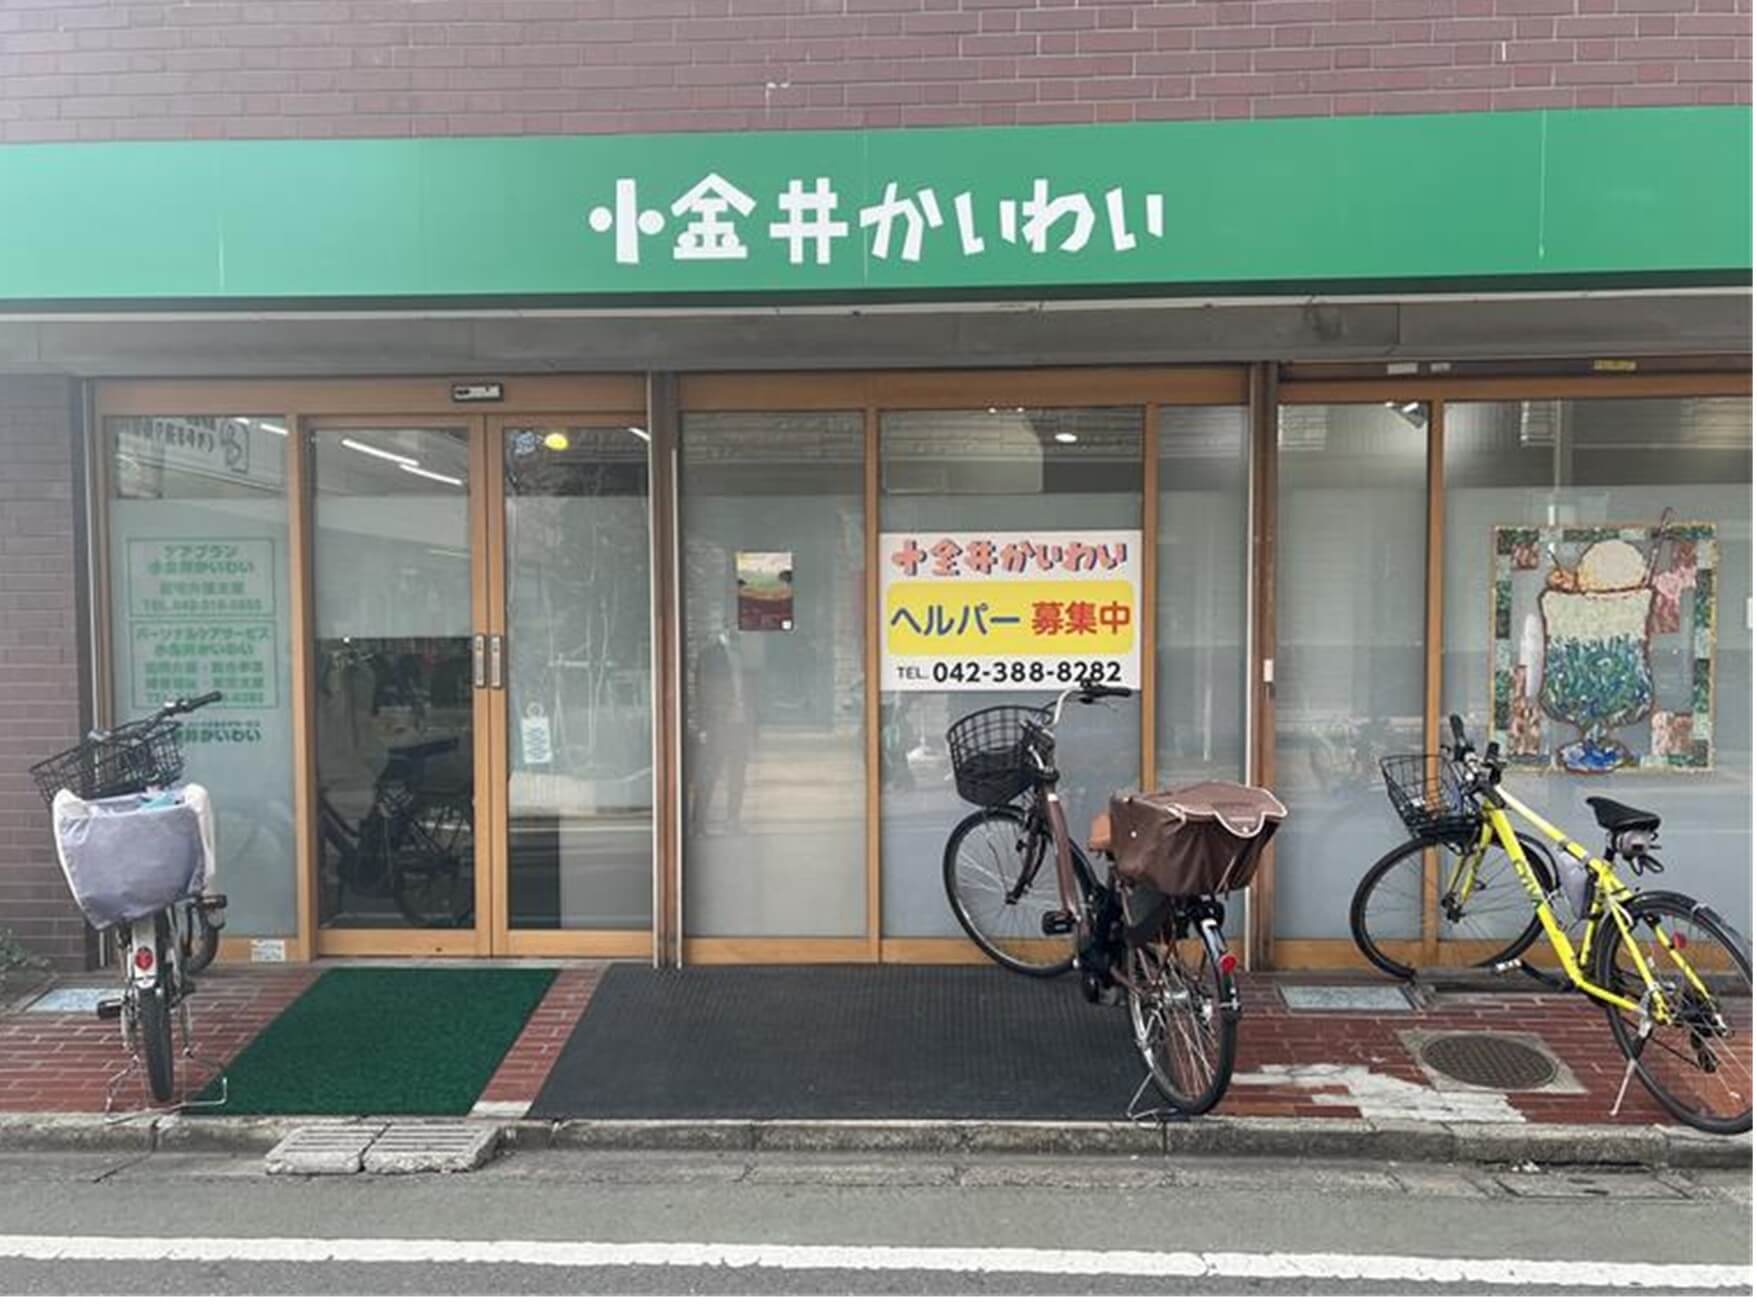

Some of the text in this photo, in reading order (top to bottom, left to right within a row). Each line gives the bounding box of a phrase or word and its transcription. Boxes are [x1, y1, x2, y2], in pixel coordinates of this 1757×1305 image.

[588, 173, 1163, 265] 小金井かいわい
[892, 538, 1128, 576] 小金井かいわい
[891, 600, 1132, 637] ヘルパー 募集中
[932, 661, 1122, 683] 042-388-8282
